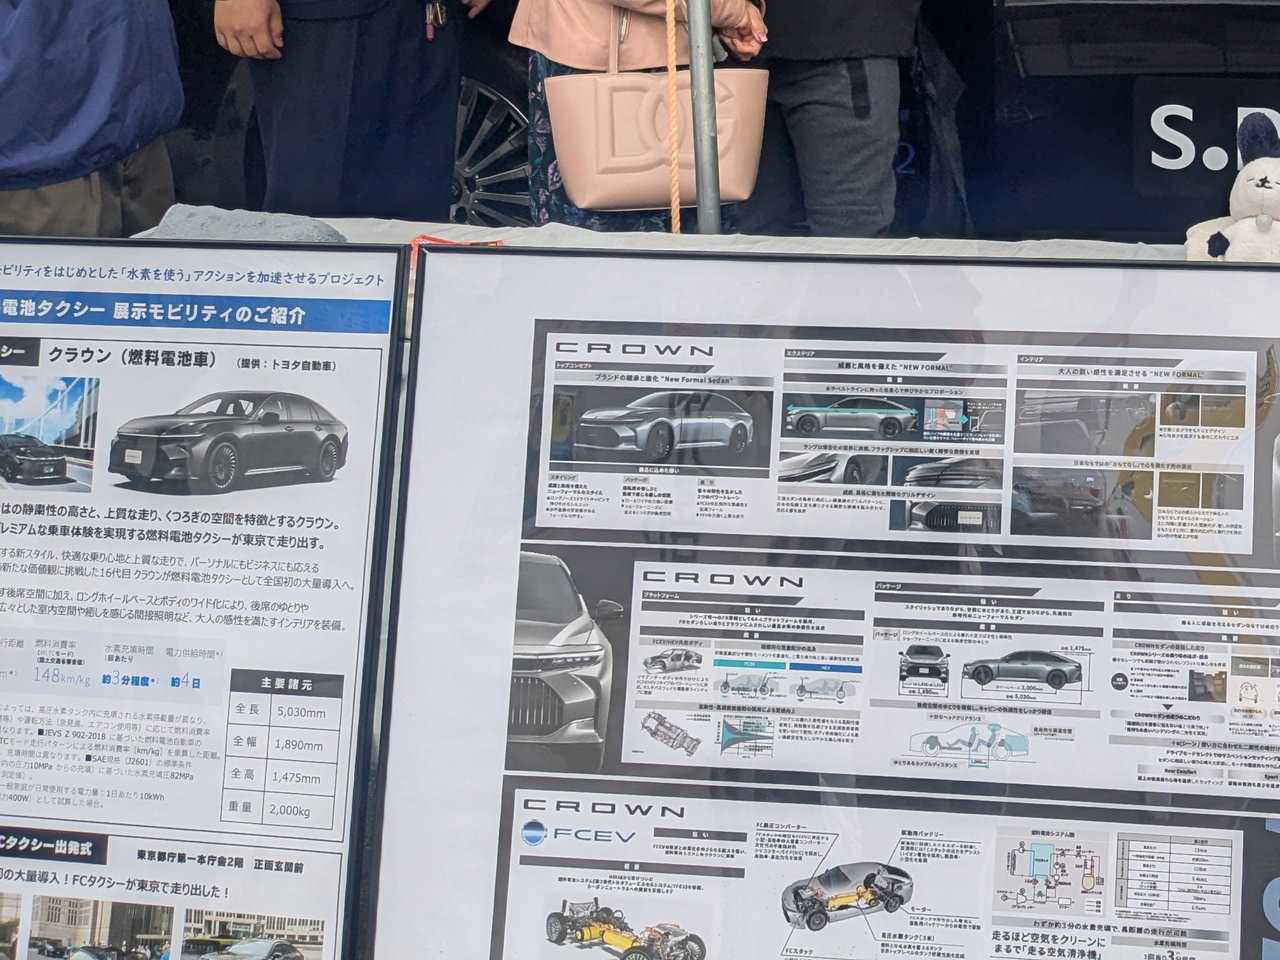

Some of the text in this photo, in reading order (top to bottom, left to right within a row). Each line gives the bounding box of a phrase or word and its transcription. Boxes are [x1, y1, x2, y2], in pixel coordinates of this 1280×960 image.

[0, 264, 385, 287] ビリティをはじめとした「水素を使う」アクションを加速させるプロジェクト
[113, 302, 306, 326] 展示モビリティのご紹介
[556, 342, 713, 357] CROWN
[236, 359, 337, 373] (提供:トヨタ自動車)
[0, 563, 132, 580] 新たな価値観に挑戦した16代目
[643, 571, 804, 588] CROWN
[277, 705, 326, 719] 5,030mm
[275, 738, 323, 752] 1,890mm
[272, 771, 321, 785] 1,475mm
[269, 804, 311, 818] 2,000kg
[523, 799, 685, 818] CROWN
[554, 828, 636, 844] FCEV
[991, 930, 1107, 947] 走るほど空気をクリーンに
[994, 943, 1103, 960] まるで「走る空気清浄機」
